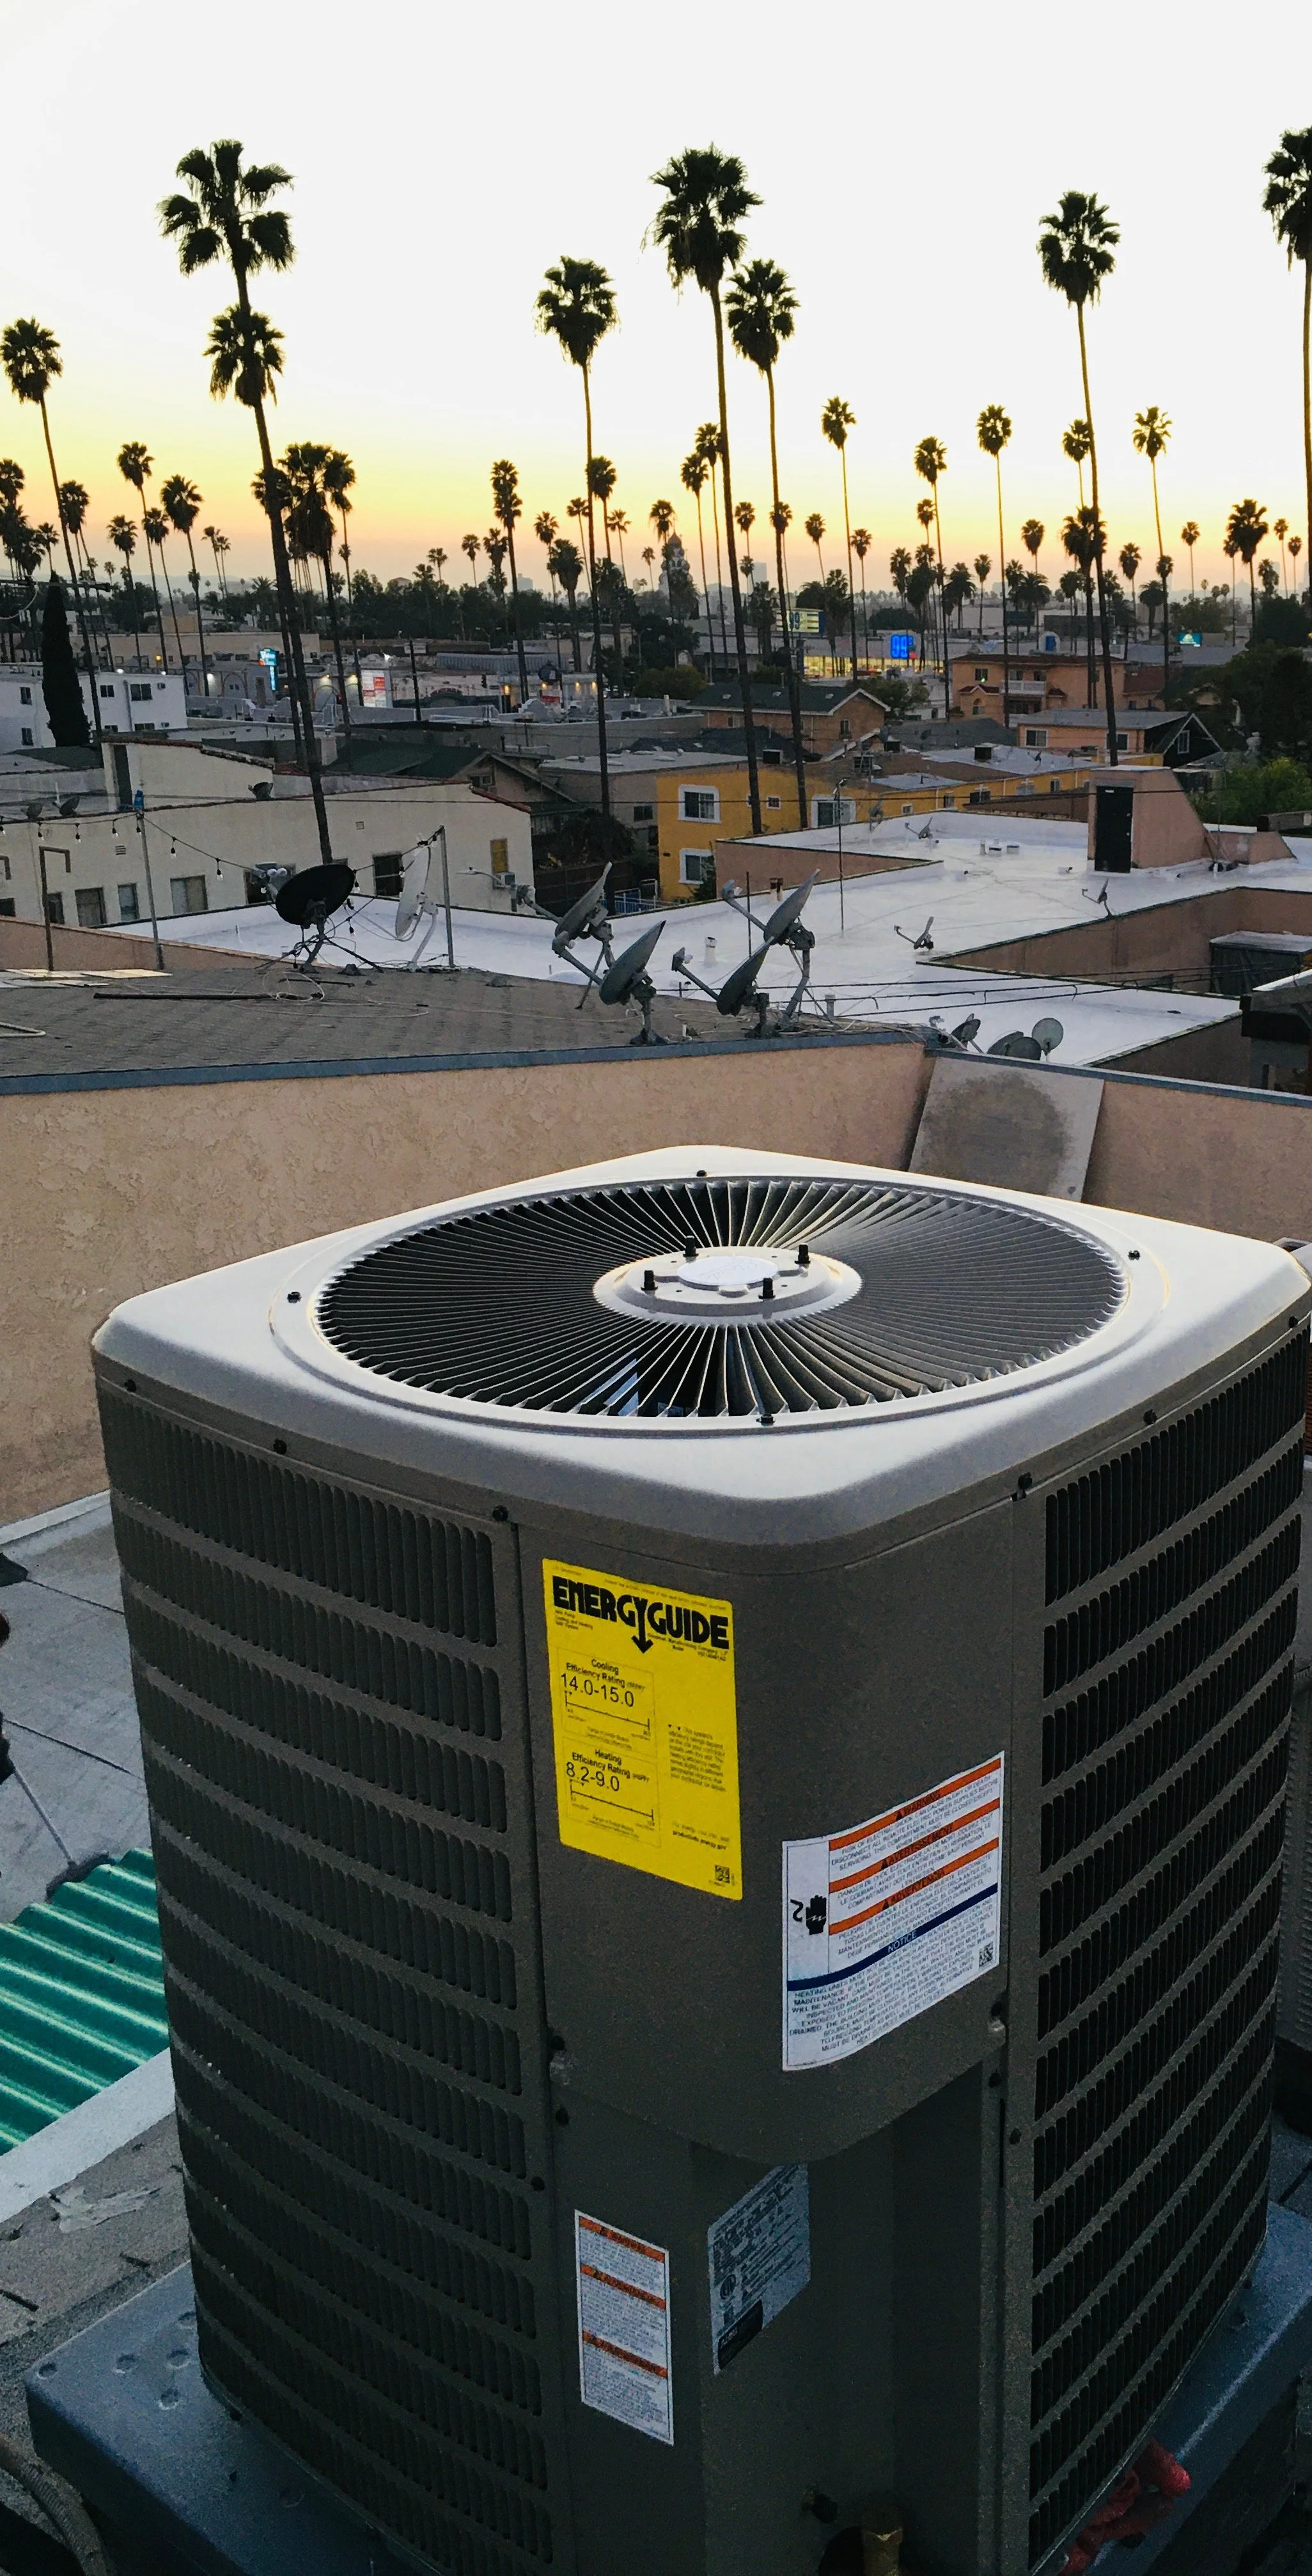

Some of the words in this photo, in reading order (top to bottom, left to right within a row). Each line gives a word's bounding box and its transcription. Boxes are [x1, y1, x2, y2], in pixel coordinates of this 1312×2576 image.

[566, 1662, 600, 1680] Efficiency
[602, 1672, 625, 1689] Rating
[591, 1659, 619, 1675] Cooling
[561, 1672, 634, 1707] 14.0-15.0
[572, 1752, 606, 1771] Efficiency
[607, 1762, 631, 1780] Rating
[595, 1749, 622, 1766] Heating
[566, 1761, 620, 1792] 8.2-9.0
[887, 1929, 917, 1953] NOTICE
